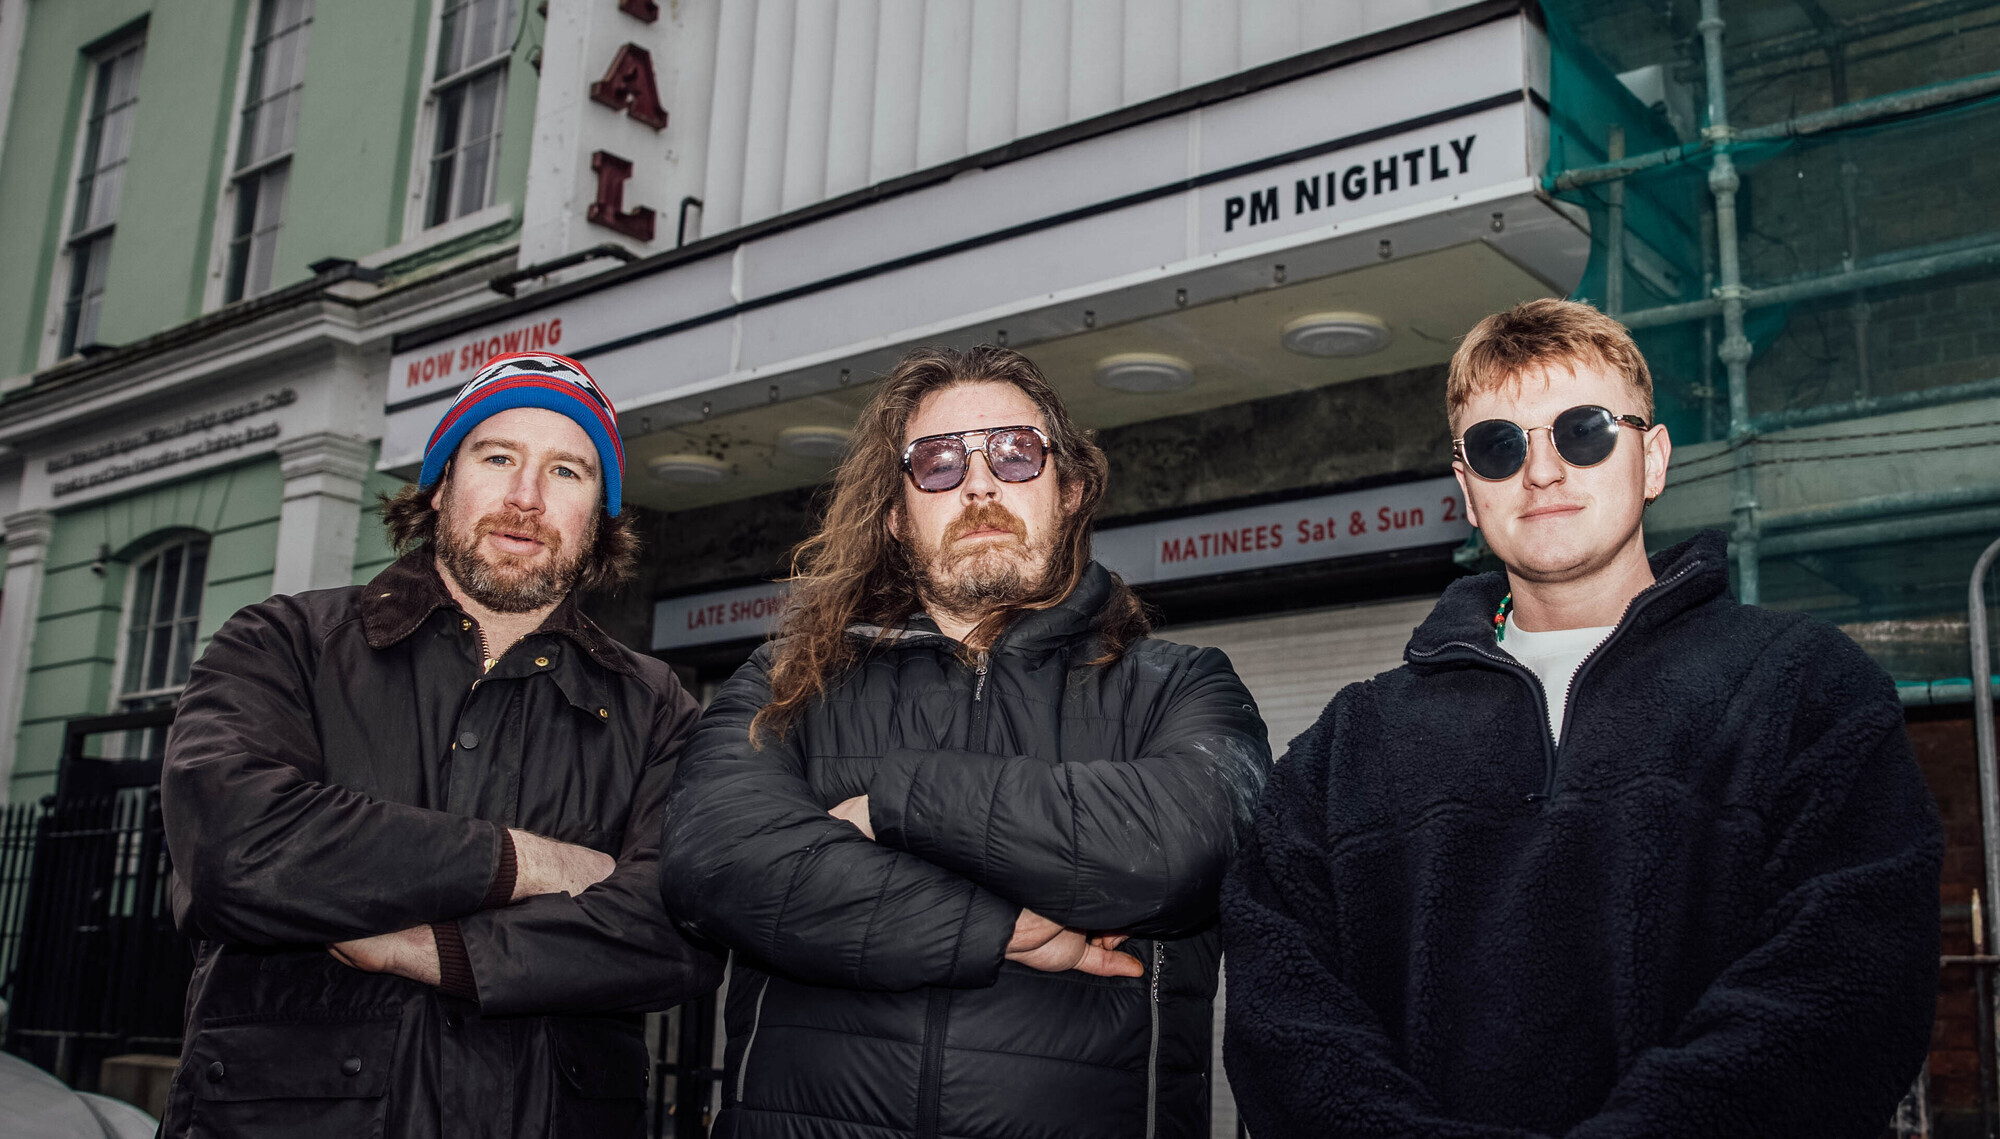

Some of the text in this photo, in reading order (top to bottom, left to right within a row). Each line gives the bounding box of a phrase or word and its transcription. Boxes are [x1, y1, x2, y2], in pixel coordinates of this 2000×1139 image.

[587, 0, 669, 243] AL
[1224, 134, 1477, 233] PM NIGHTLY
[407, 318, 562, 389] NOW SHOWING
[1161, 524, 1283, 564] MATINEES
[1297, 517, 1336, 544] Sat
[1348, 510, 1367, 536] &
[1377, 506, 1424, 532] Sun
[687, 604, 726, 630] LATE
